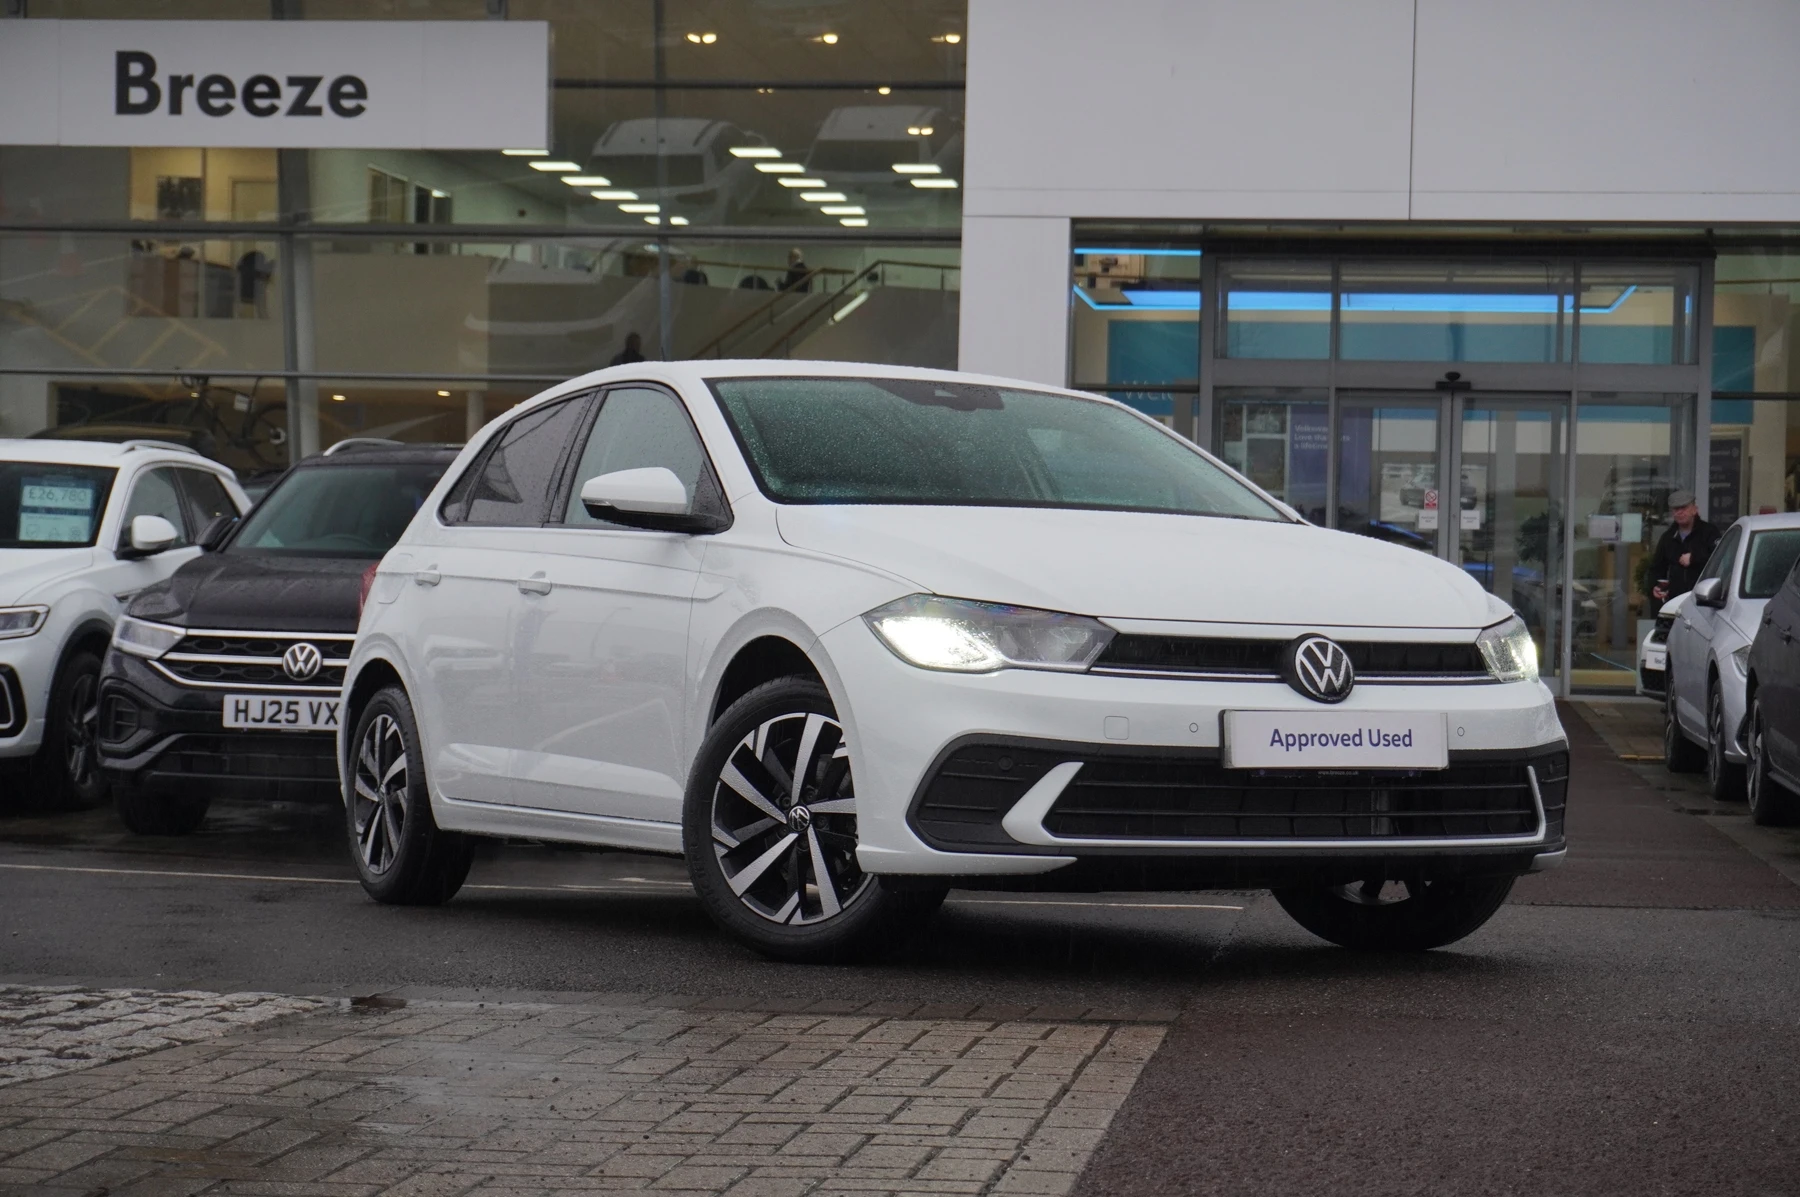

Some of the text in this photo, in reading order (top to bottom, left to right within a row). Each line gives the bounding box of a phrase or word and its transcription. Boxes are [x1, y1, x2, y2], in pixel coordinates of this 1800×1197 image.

[115, 50, 368, 118] Breeze
[234, 699, 340, 725] HJ25 VX
[1269, 728, 1413, 752] Approved Used
